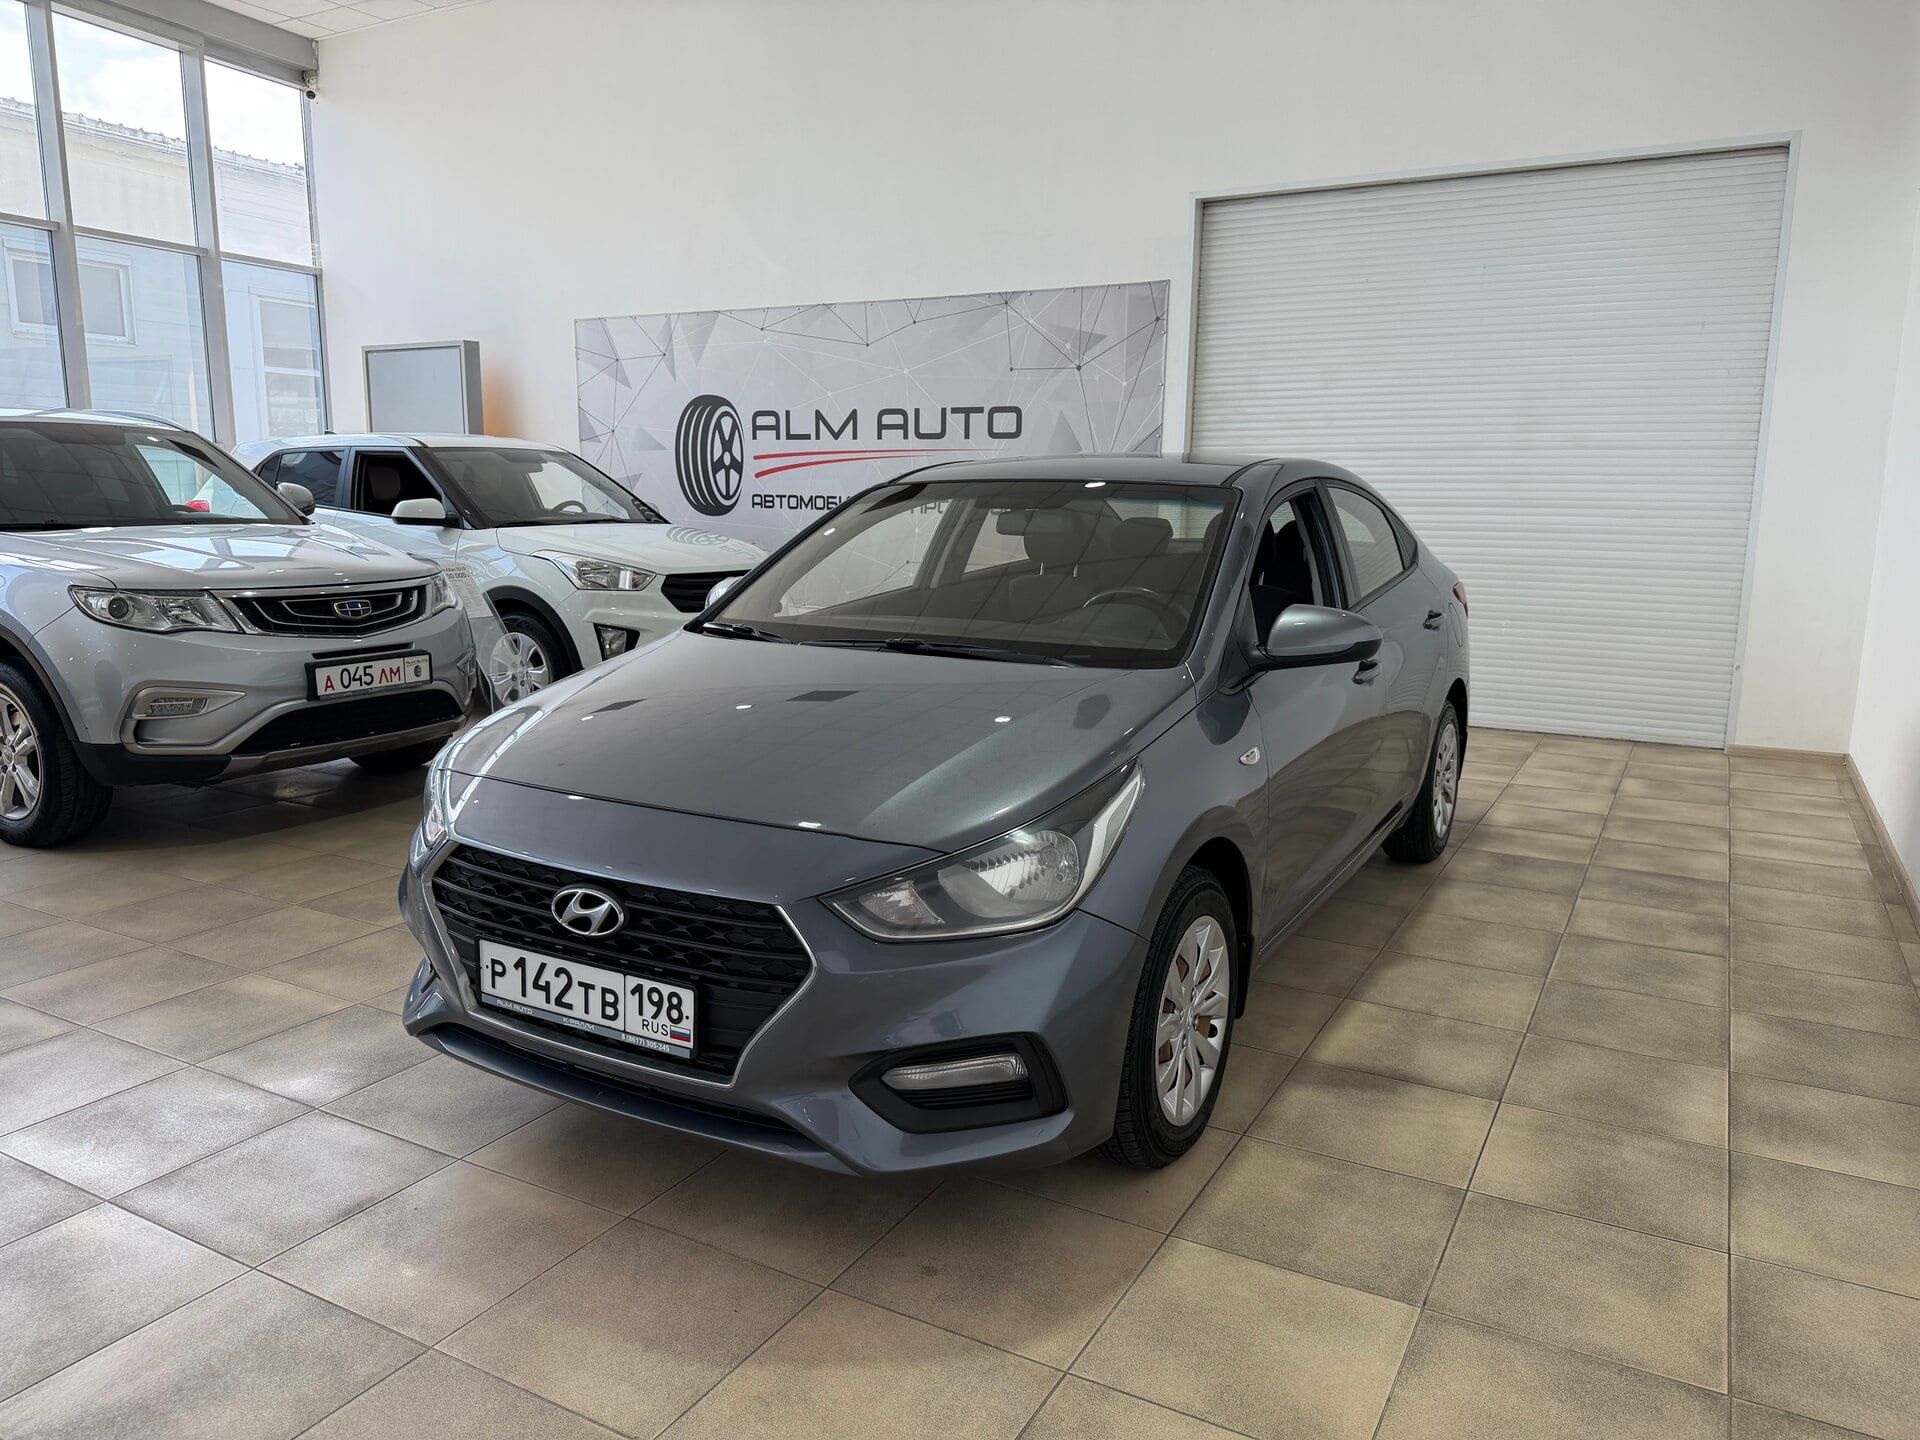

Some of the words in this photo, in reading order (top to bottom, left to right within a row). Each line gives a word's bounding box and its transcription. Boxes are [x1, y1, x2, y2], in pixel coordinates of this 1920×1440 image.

[752, 408, 858, 441] ALM
[876, 405, 1023, 441] AUTO
[340, 665, 375, 690] 045
[513, 1003, 533, 1015] AUTO
[630, 983, 684, 1025] 198
[641, 1019, 669, 1037] RUS
